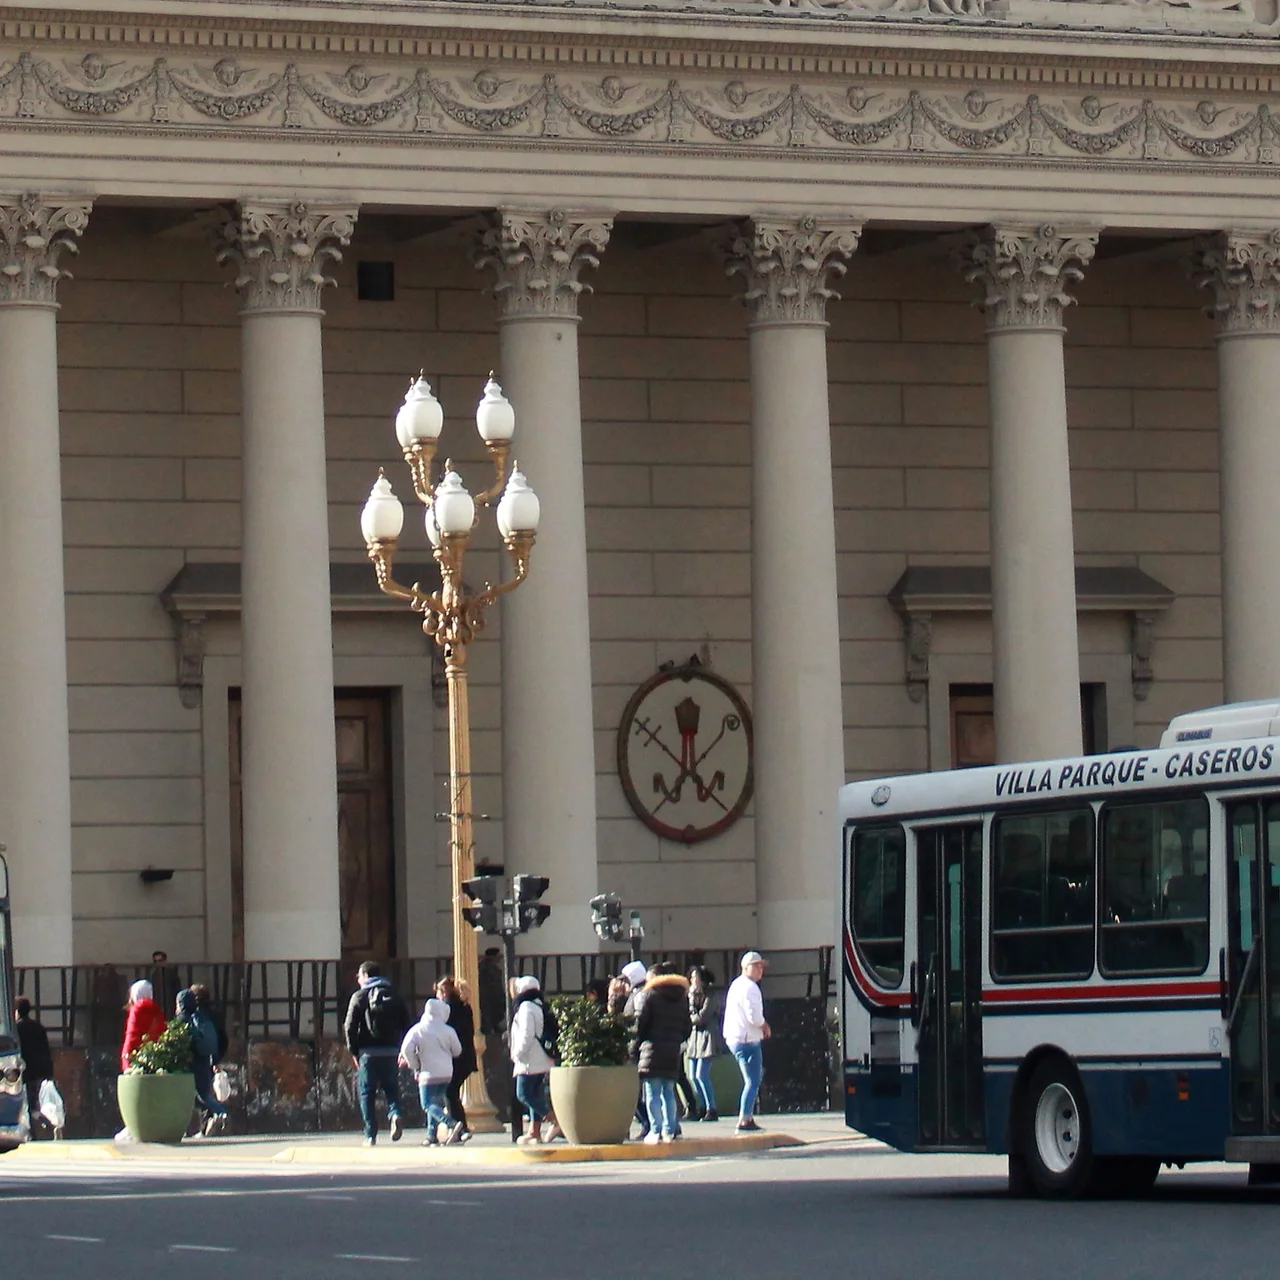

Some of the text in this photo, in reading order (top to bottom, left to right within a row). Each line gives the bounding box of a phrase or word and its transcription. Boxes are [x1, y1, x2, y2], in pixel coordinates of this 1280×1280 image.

[995, 767, 1053, 796] VILLA
[1057, 756, 1150, 789] PARQUE
[1164, 743, 1275, 779] CASEROS
